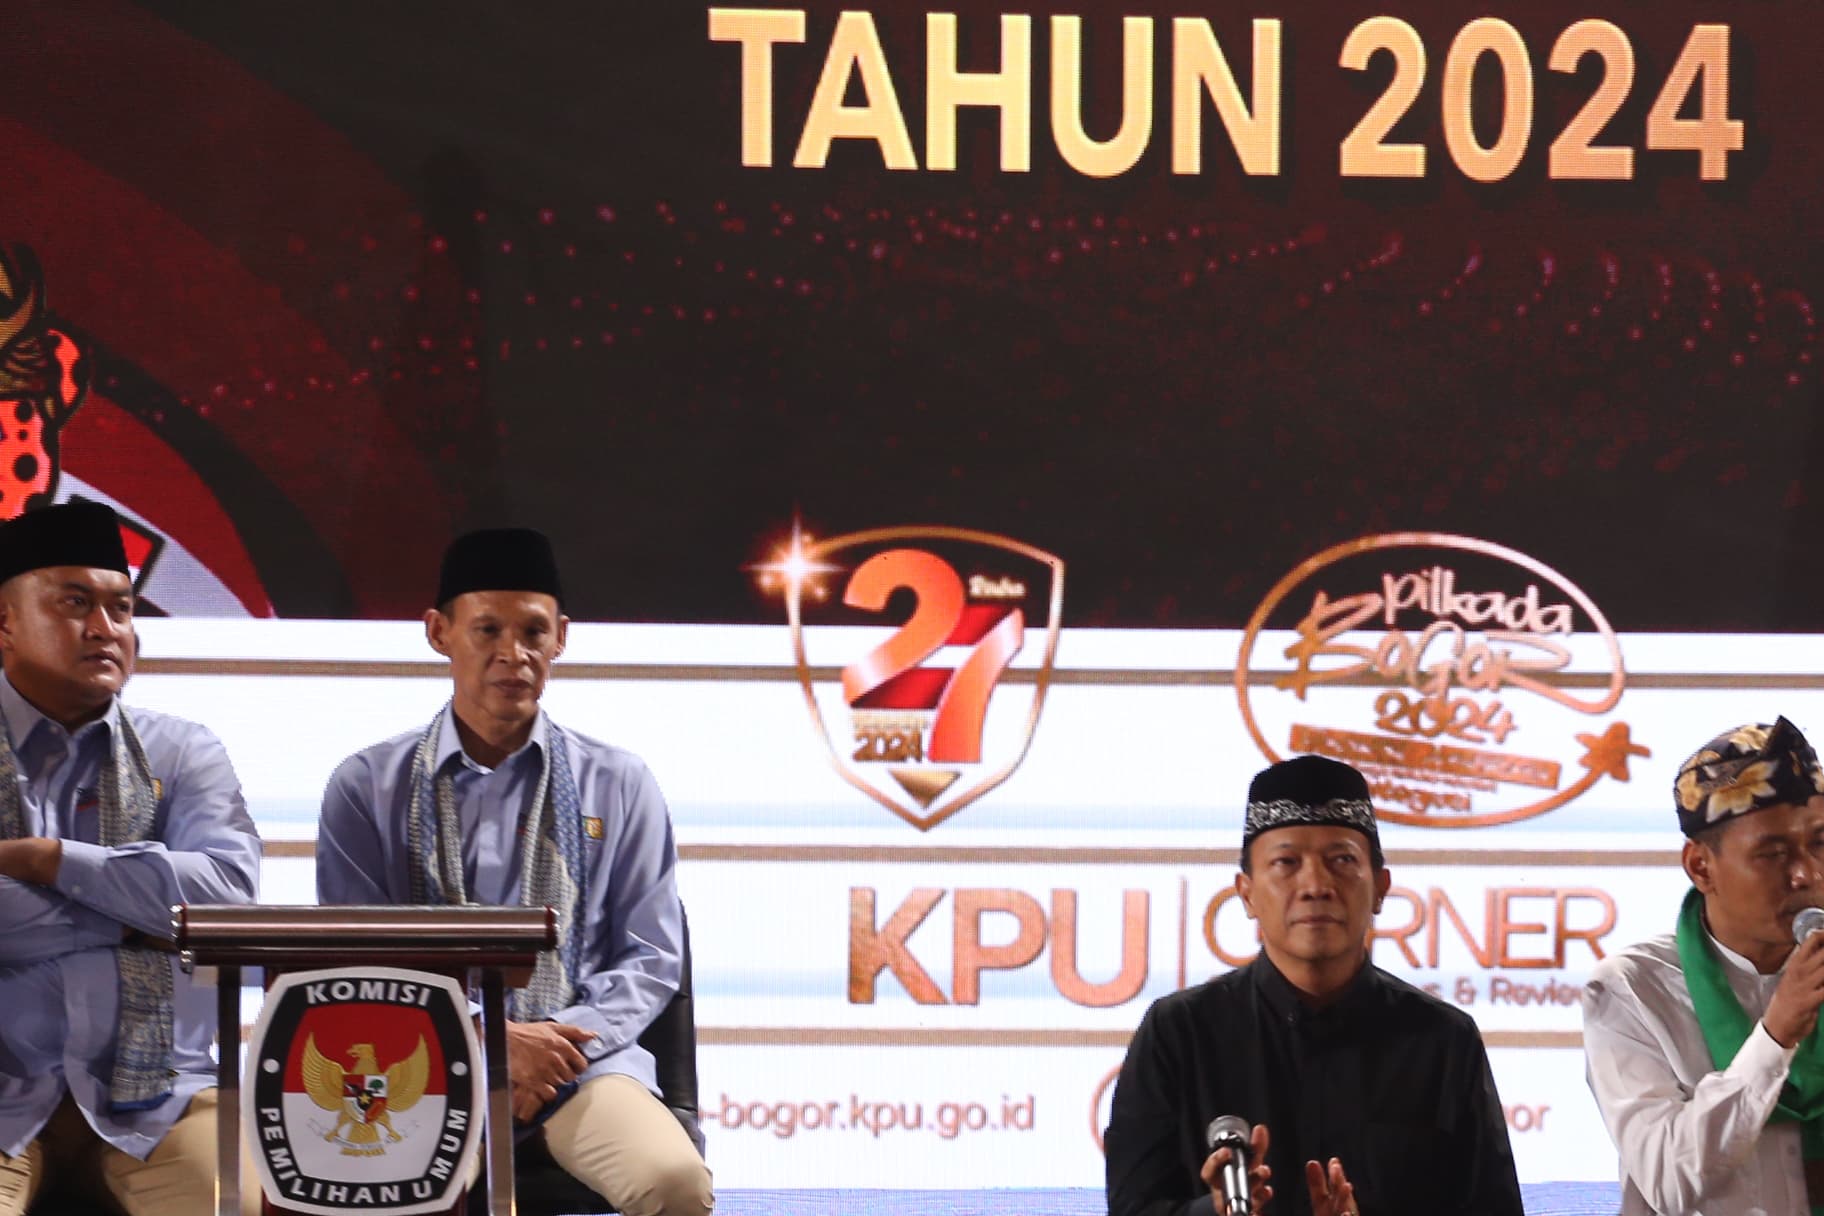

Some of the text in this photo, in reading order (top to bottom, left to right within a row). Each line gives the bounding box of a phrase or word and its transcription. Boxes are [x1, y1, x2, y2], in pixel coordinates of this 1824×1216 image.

[708, 8, 1746, 182] TAHUN 2024
[842, 548, 1025, 764] 27
[1374, 690, 1518, 744] 2024
[306, 980, 432, 1007] KOMISI
[847, 885, 1618, 1008] KPU CRNER
[260, 1107, 469, 1204] PEMILIHAN UMUM
[698, 1093, 1037, 1139] -bogor.kpu.go.id
